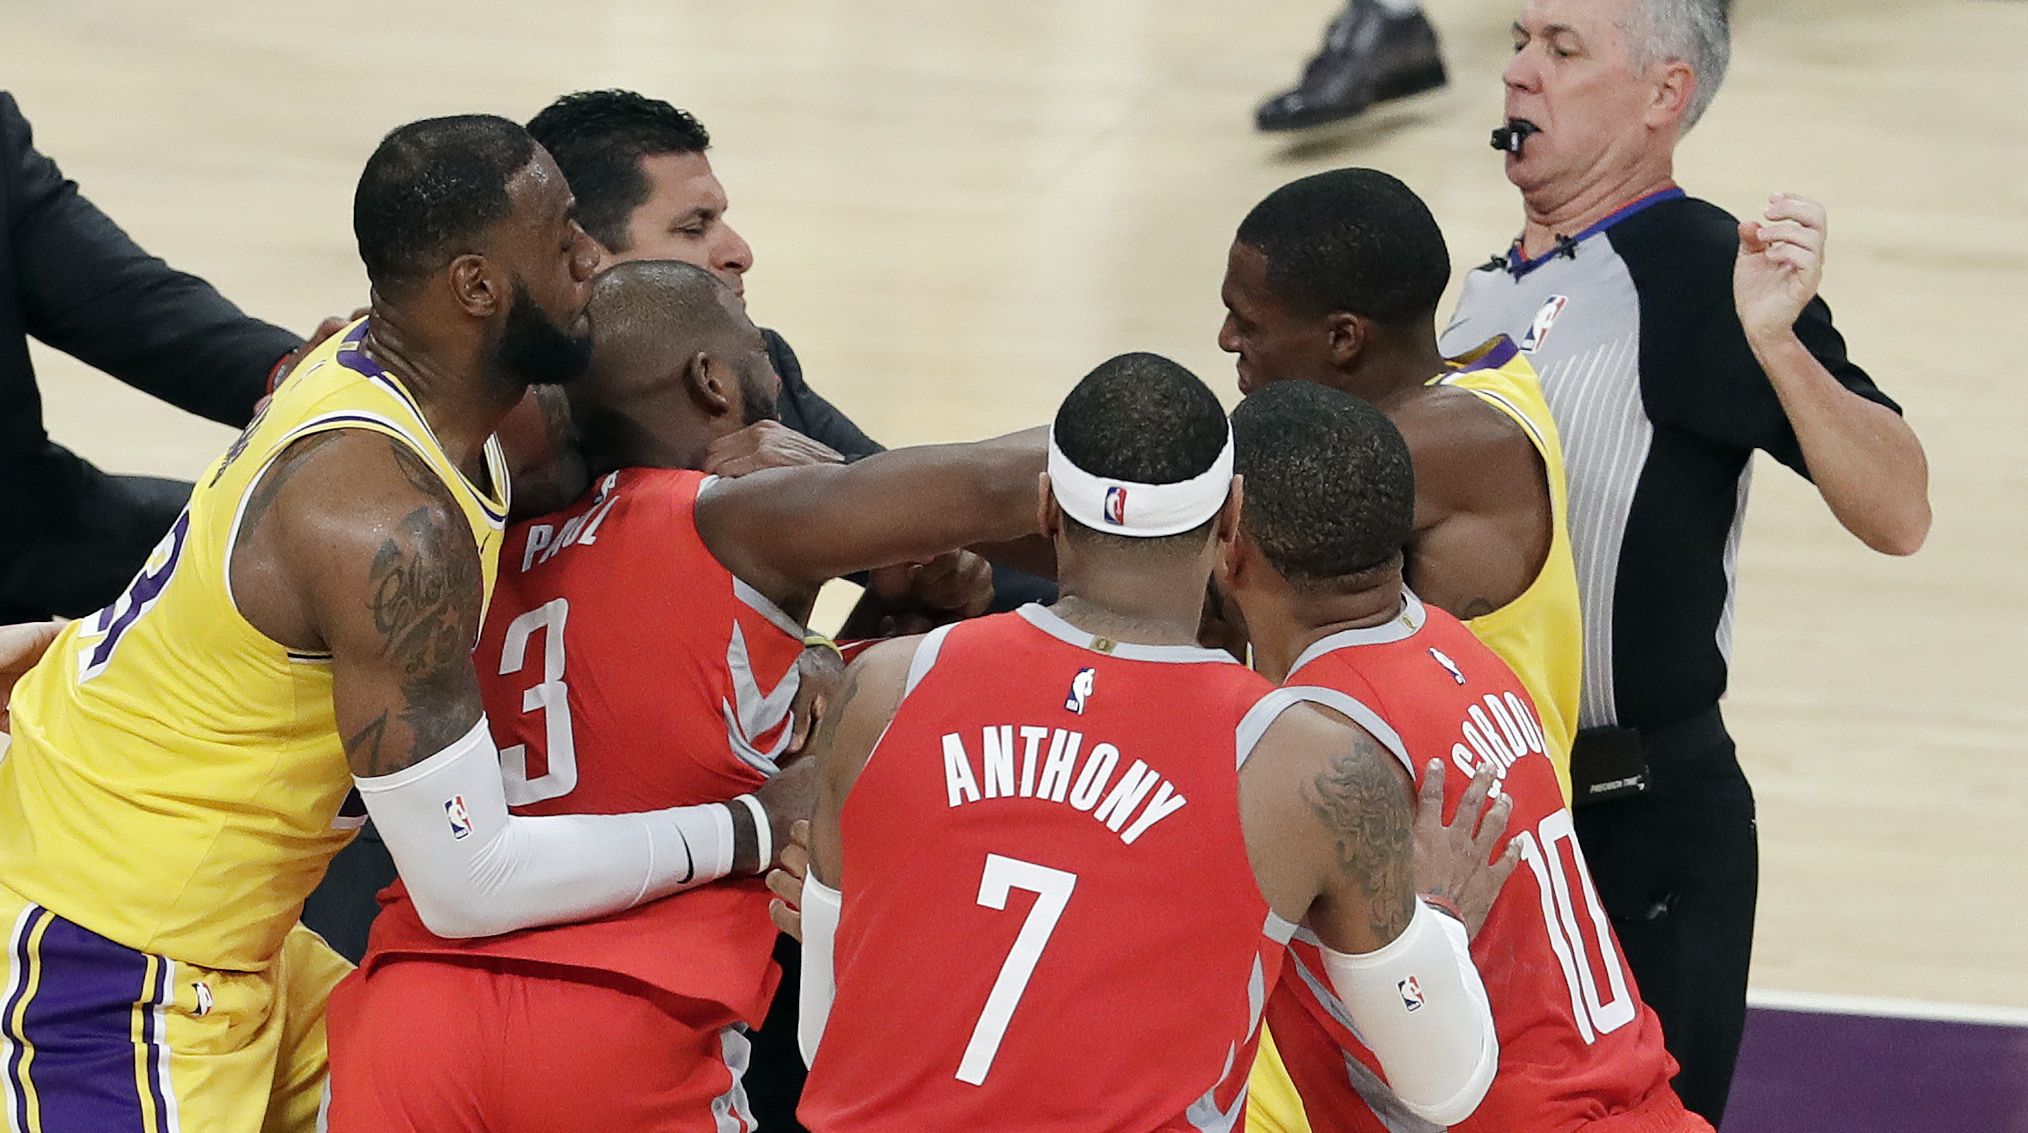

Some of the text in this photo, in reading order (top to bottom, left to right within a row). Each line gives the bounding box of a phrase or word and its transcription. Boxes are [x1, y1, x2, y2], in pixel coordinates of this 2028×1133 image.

[521, 495, 620, 572] PAUL
[499, 597, 579, 806] 3
[941, 725, 1187, 845] ANTHONY
[955, 853, 1077, 1086] 7
[1519, 807, 1636, 1045] 10
